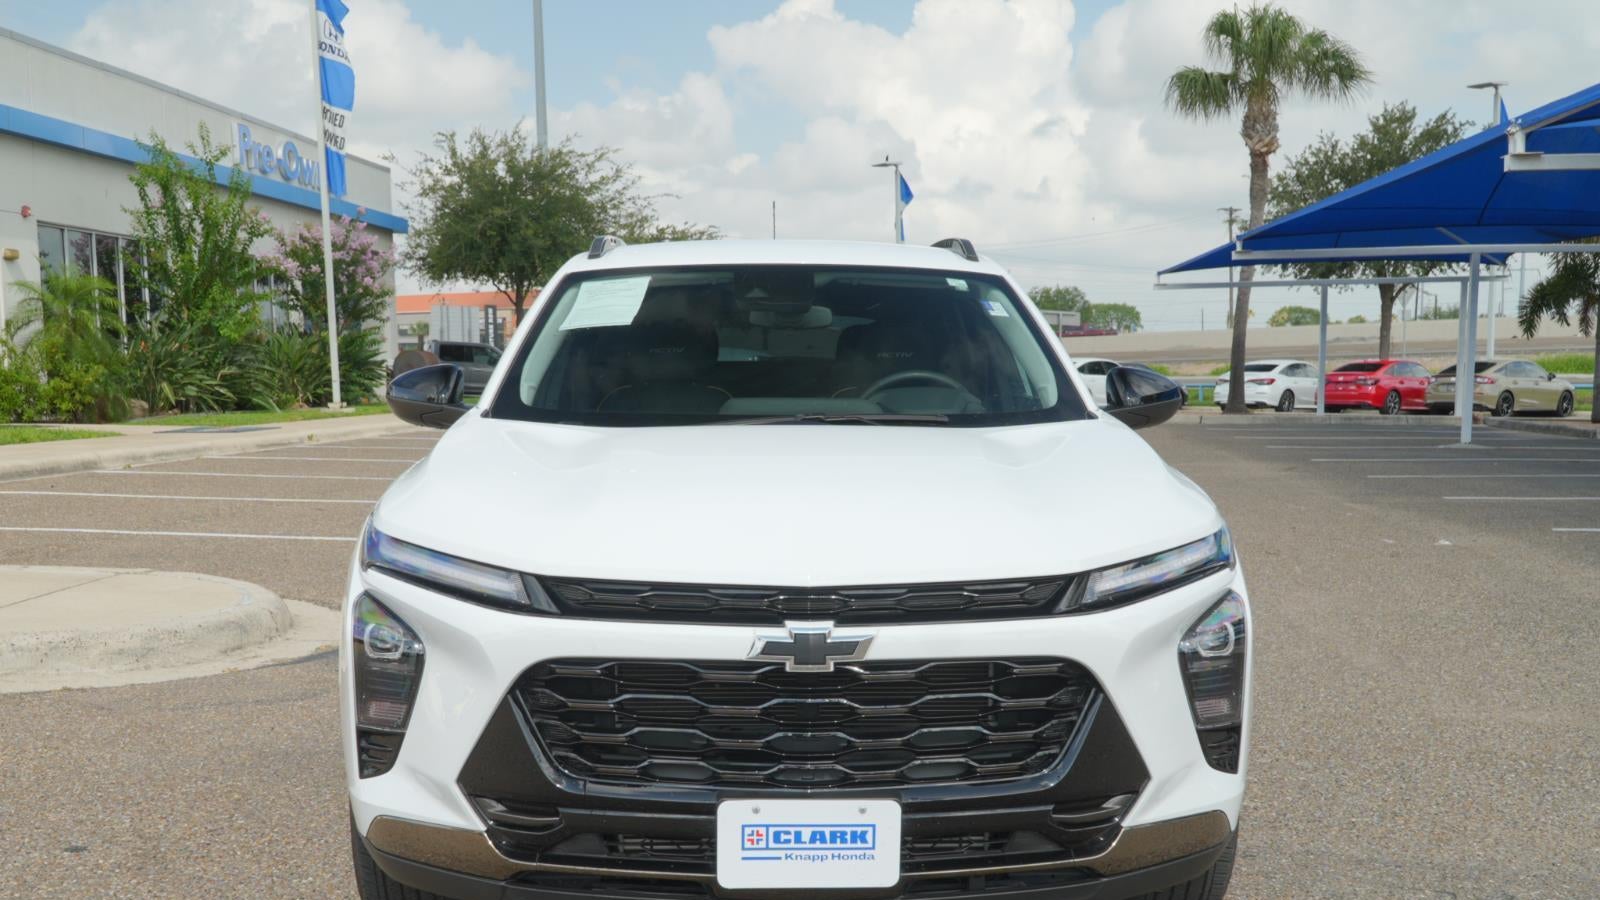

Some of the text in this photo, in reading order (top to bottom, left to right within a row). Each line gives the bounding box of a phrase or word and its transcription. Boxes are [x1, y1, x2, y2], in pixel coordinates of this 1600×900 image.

[773, 830, 869, 844] CLARK
[785, 852, 875, 863] Knapp Honda
